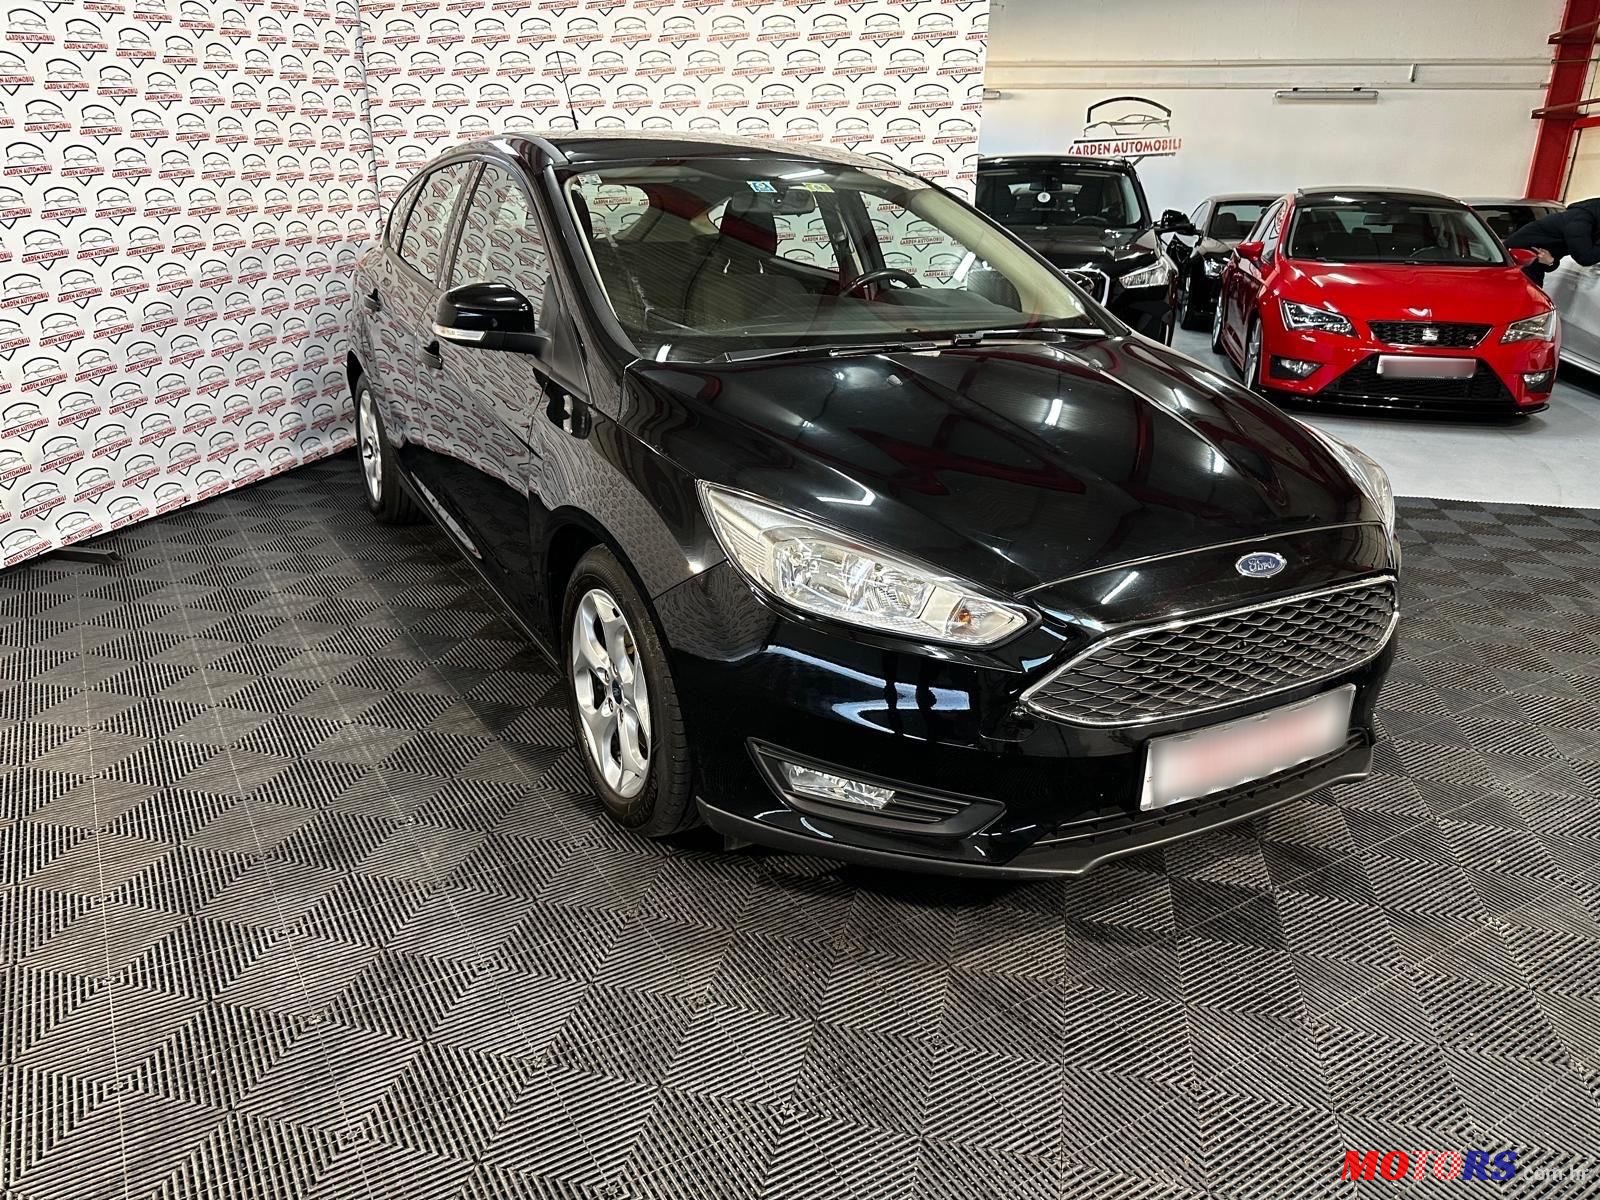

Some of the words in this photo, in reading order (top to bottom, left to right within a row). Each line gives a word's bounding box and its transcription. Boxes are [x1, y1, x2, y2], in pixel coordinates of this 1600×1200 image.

[1113, 138, 1182, 154] AUTOMOBILI
[22, 164, 52, 173] AUTOMOBILI
[2, 207, 32, 218] AUTOMOBILI
[59, 206, 87, 216] AUTOMOBILI
[40, 248, 69, 259] AUTOMOBILI
[0, 299, 19, 308] GARDEN
[20, 292, 50, 304] AUTOMOBILI
[57, 329, 85, 341] AUTOMOBILI
[0, 337, 30, 350] AUTOMOBILI
[39, 372, 68, 386] AUTOMOBILI
[1, 428, 19, 439] GARDEN
[20, 418, 49, 433] AUTOMOBILI
[57, 450, 85, 465] AUTOMOBILI
[3, 464, 32, 479] AUTOMOBILI
[38, 494, 66, 511] AUTOMOBILI
[4, 554, 22, 566] GARDEN
[24, 540, 51, 560] AUTOMOBILI
[1248, 557, 1276, 572] Ford
